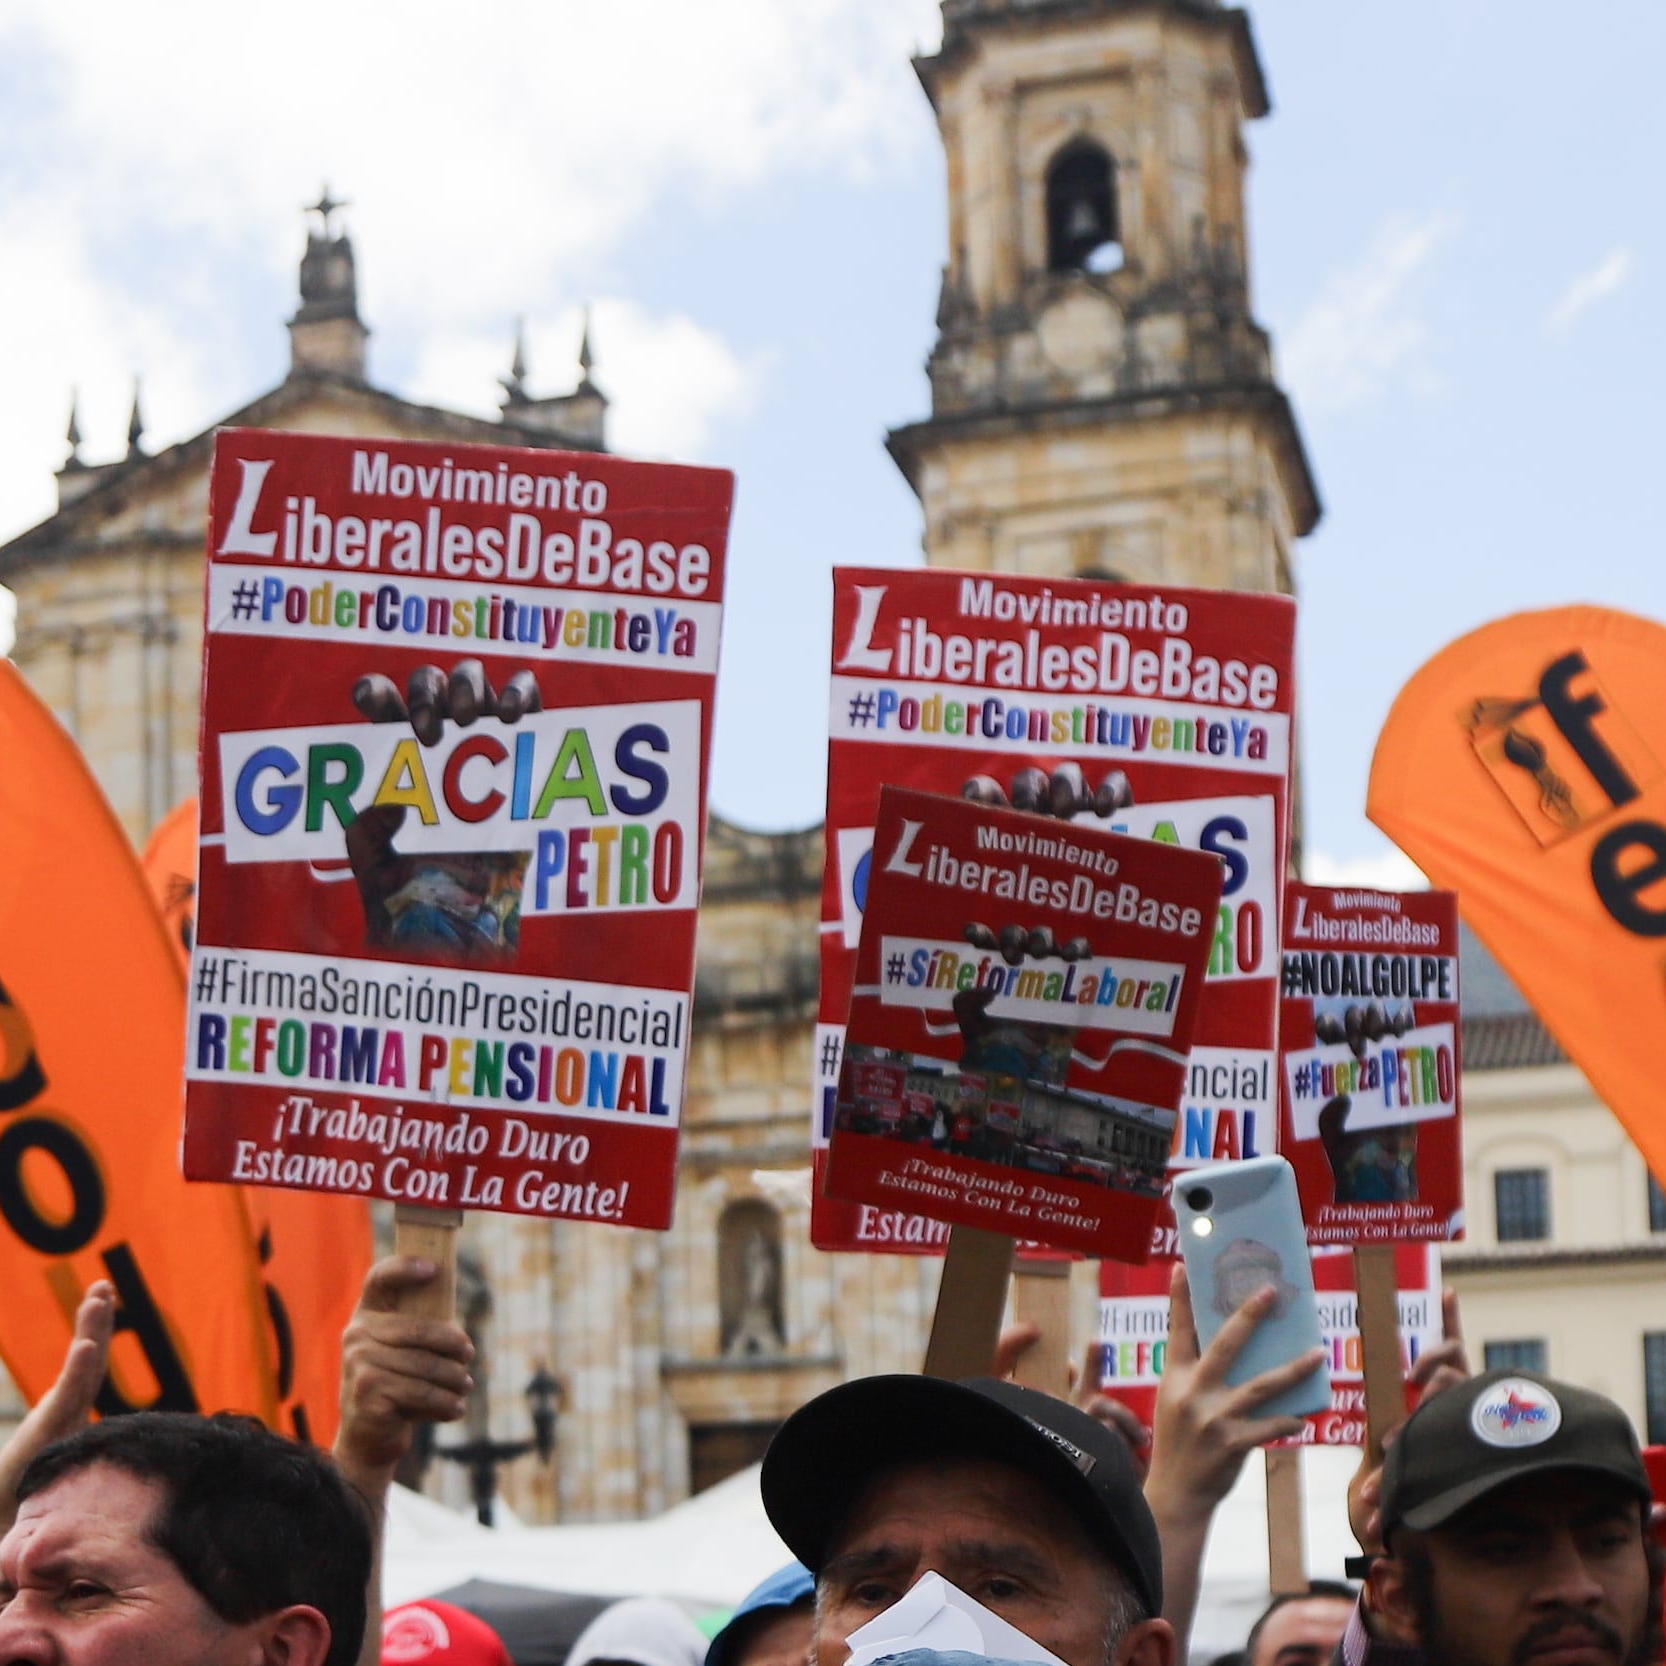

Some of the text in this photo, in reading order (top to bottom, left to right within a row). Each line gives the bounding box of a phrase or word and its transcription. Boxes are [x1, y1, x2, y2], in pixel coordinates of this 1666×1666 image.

[352, 450, 608, 515] Movimiento
[217, 457, 711, 594] LiberalesDeBase
[231, 576, 698, 657] #PoderConstituyenteYa
[959, 578, 1189, 634] Movimiento
[836, 584, 1279, 709] LiberalesDeBase
[848, 687, 1269, 761] #PoderConstituyenteYa
[235, 723, 670, 836] GRACIAS
[536, 820, 683, 910] PETRO
[884, 818, 1203, 937] LiberalesDeBase
[976, 825, 1120, 877] Movimiento
[1293, 896, 1441, 946] LiberalesDeBase
[1333, 890, 1402, 914] Movimiento
[196, 956, 684, 1048] #FirmaSanciónPresidencial
[886, 947, 1181, 1013] #SíReformaLaboral
[1283, 951, 1452, 999] #NOALGOLPE
[197, 1012, 670, 1115] REFORMA PENSIONAL
[272, 1096, 591, 1164] ¡Trabajando Duro
[232, 1141, 630, 1219] Estamos Con La Gente!
[877, 1169, 1101, 1233] Estamos Con La Gente!
[902, 1157, 1081, 1208] ¡Trabajando Duro
[1404, 1204, 1435, 1219] Duro
[1363, 1225, 1390, 1239] Con
[1393, 1223, 1409, 1237] La
[1100, 1341, 1167, 1376] REFO
